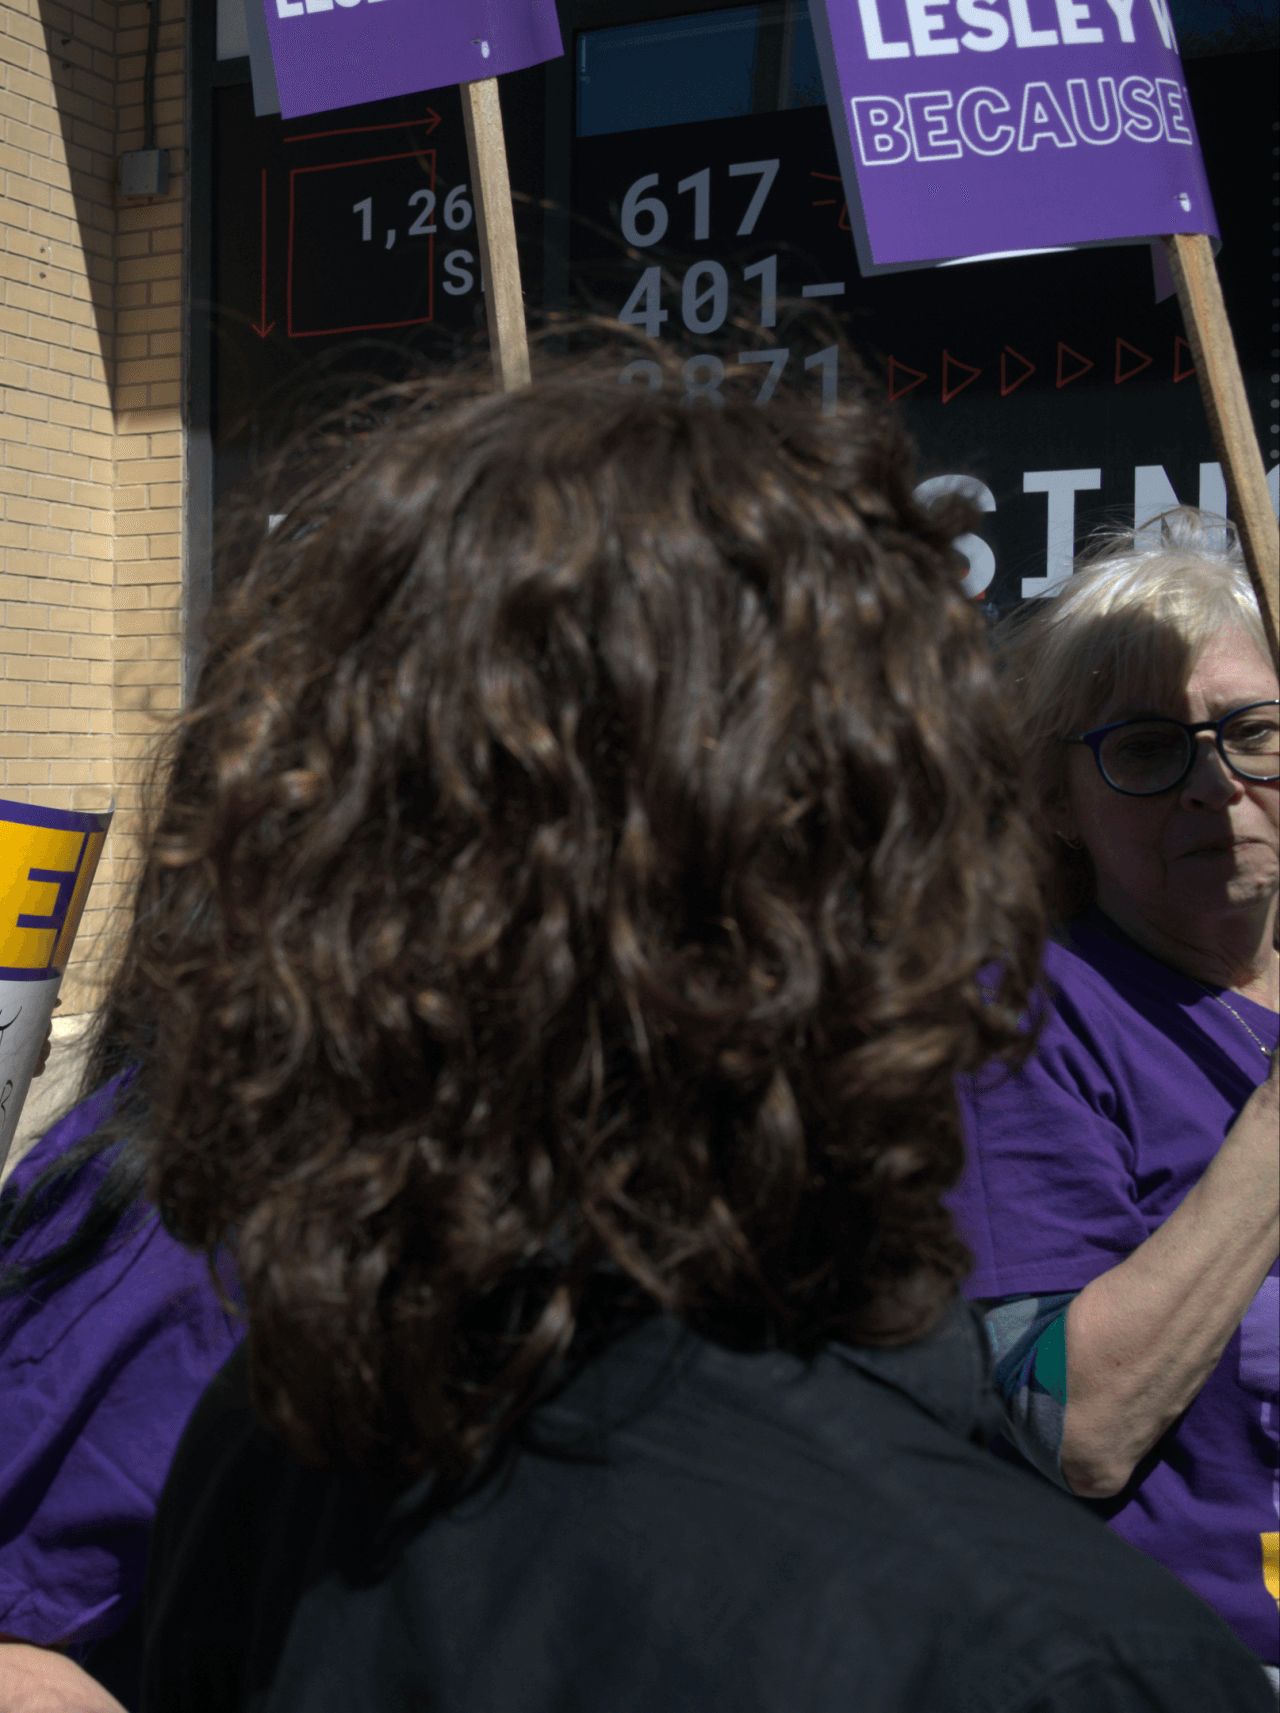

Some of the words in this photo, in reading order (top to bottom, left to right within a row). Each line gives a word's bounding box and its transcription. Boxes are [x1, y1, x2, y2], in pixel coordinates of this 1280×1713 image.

[858, 0, 1136, 59] LESLEY
[852, 76, 1193, 166] BECAUSE
[352, 184, 473, 250] 1,26
[621, 158, 781, 248] 617
[442, 249, 486, 296] S
[619, 254, 846, 338] 401-
